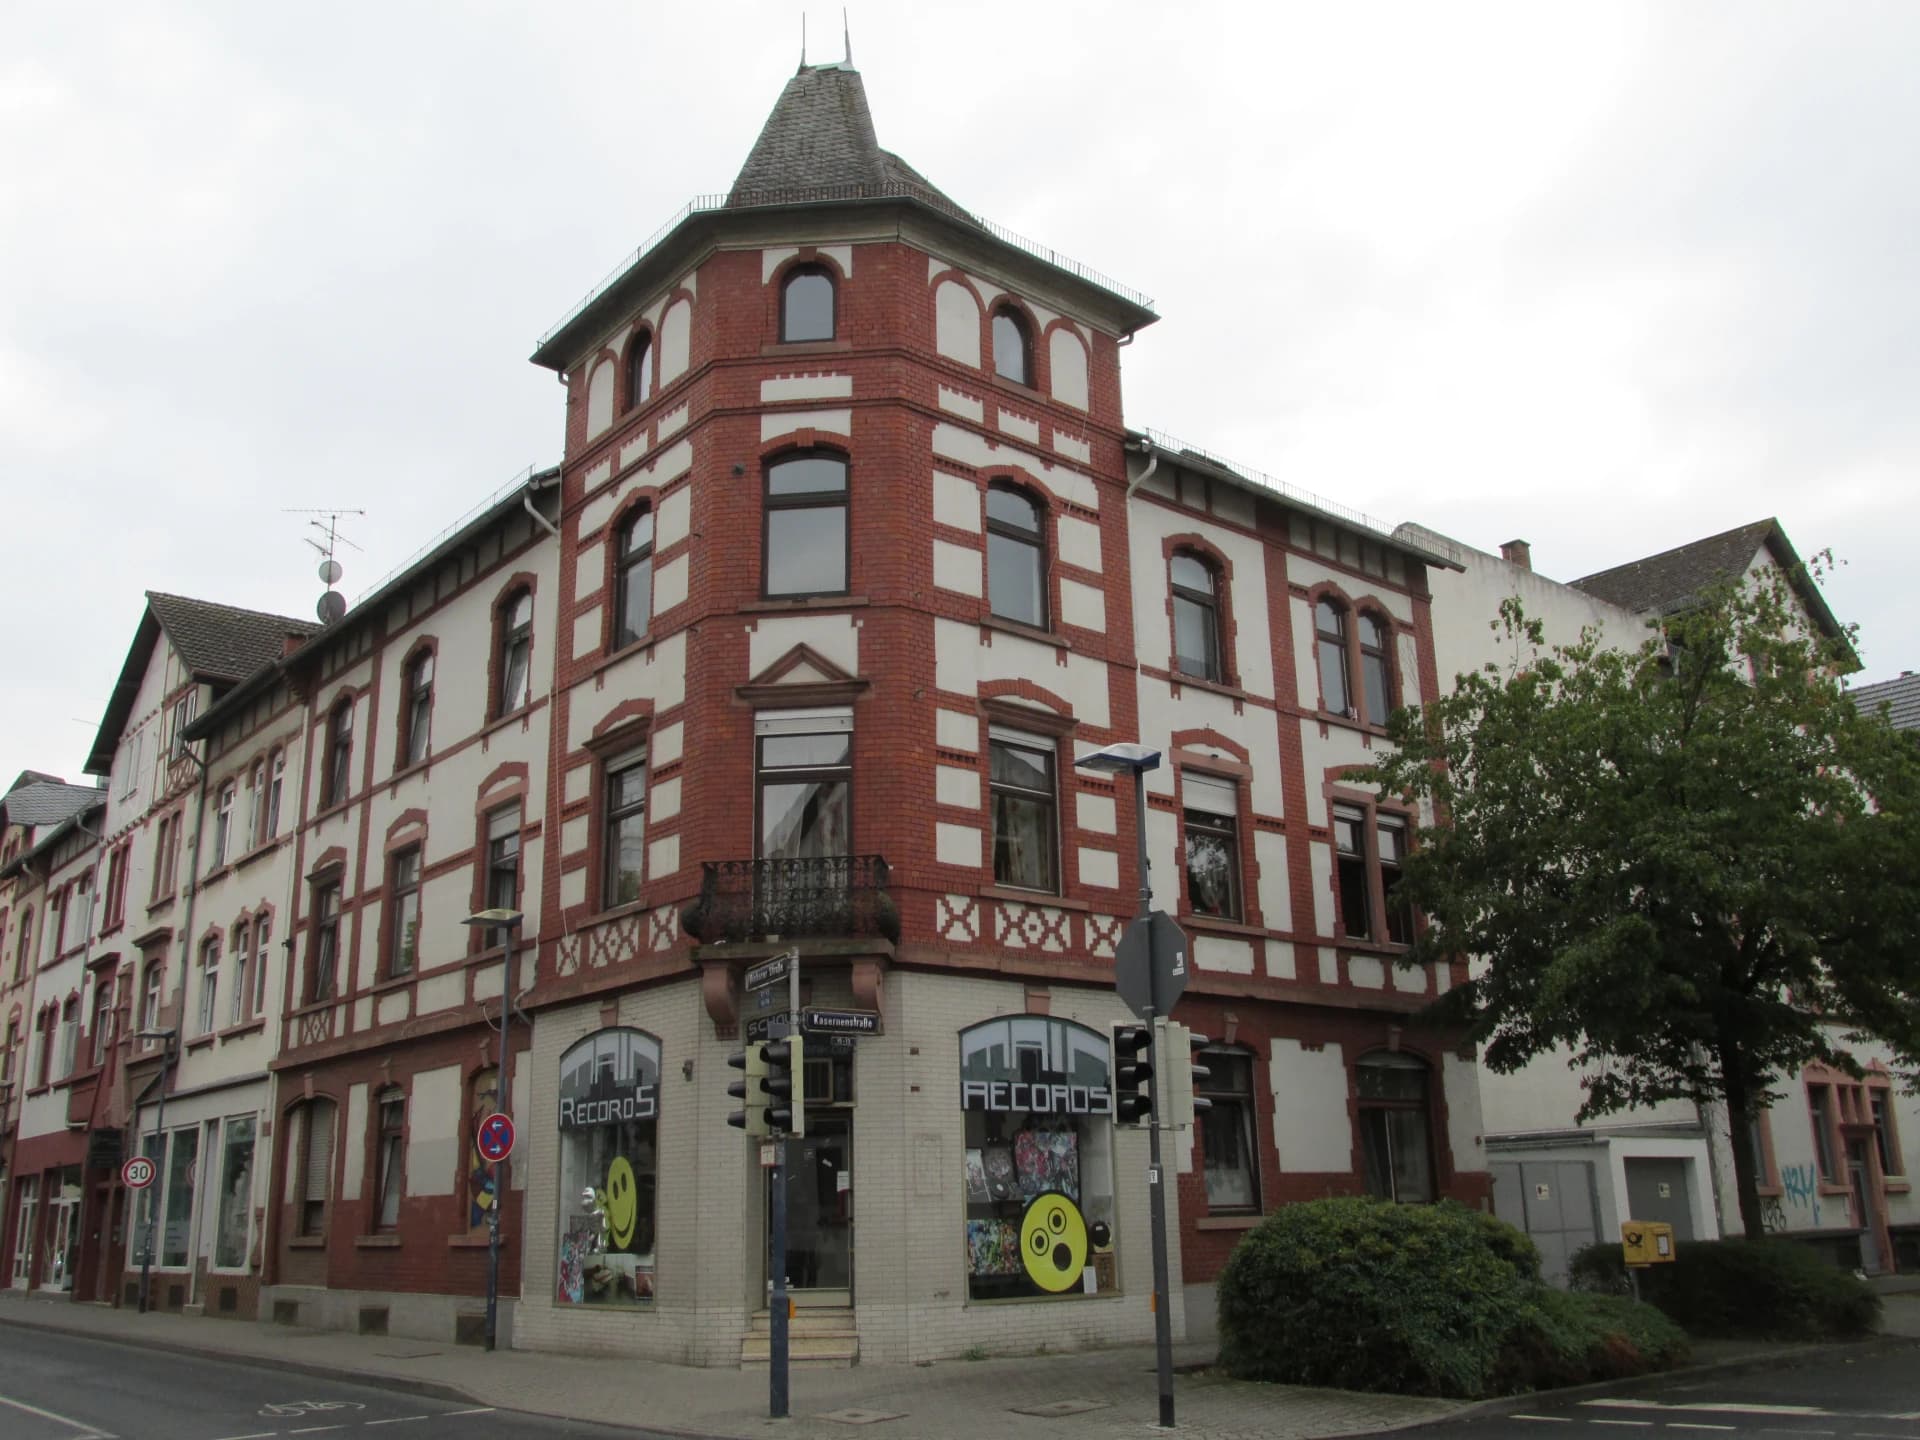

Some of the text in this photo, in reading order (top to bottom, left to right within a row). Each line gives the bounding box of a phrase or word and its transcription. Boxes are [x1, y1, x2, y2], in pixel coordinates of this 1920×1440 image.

[813, 1013, 873, 1029] Kasernenstraße
[560, 1085, 655, 1127] RECORDS
[963, 1080, 1113, 1114] RECORDS
[129, 1166, 149, 1180] 30
